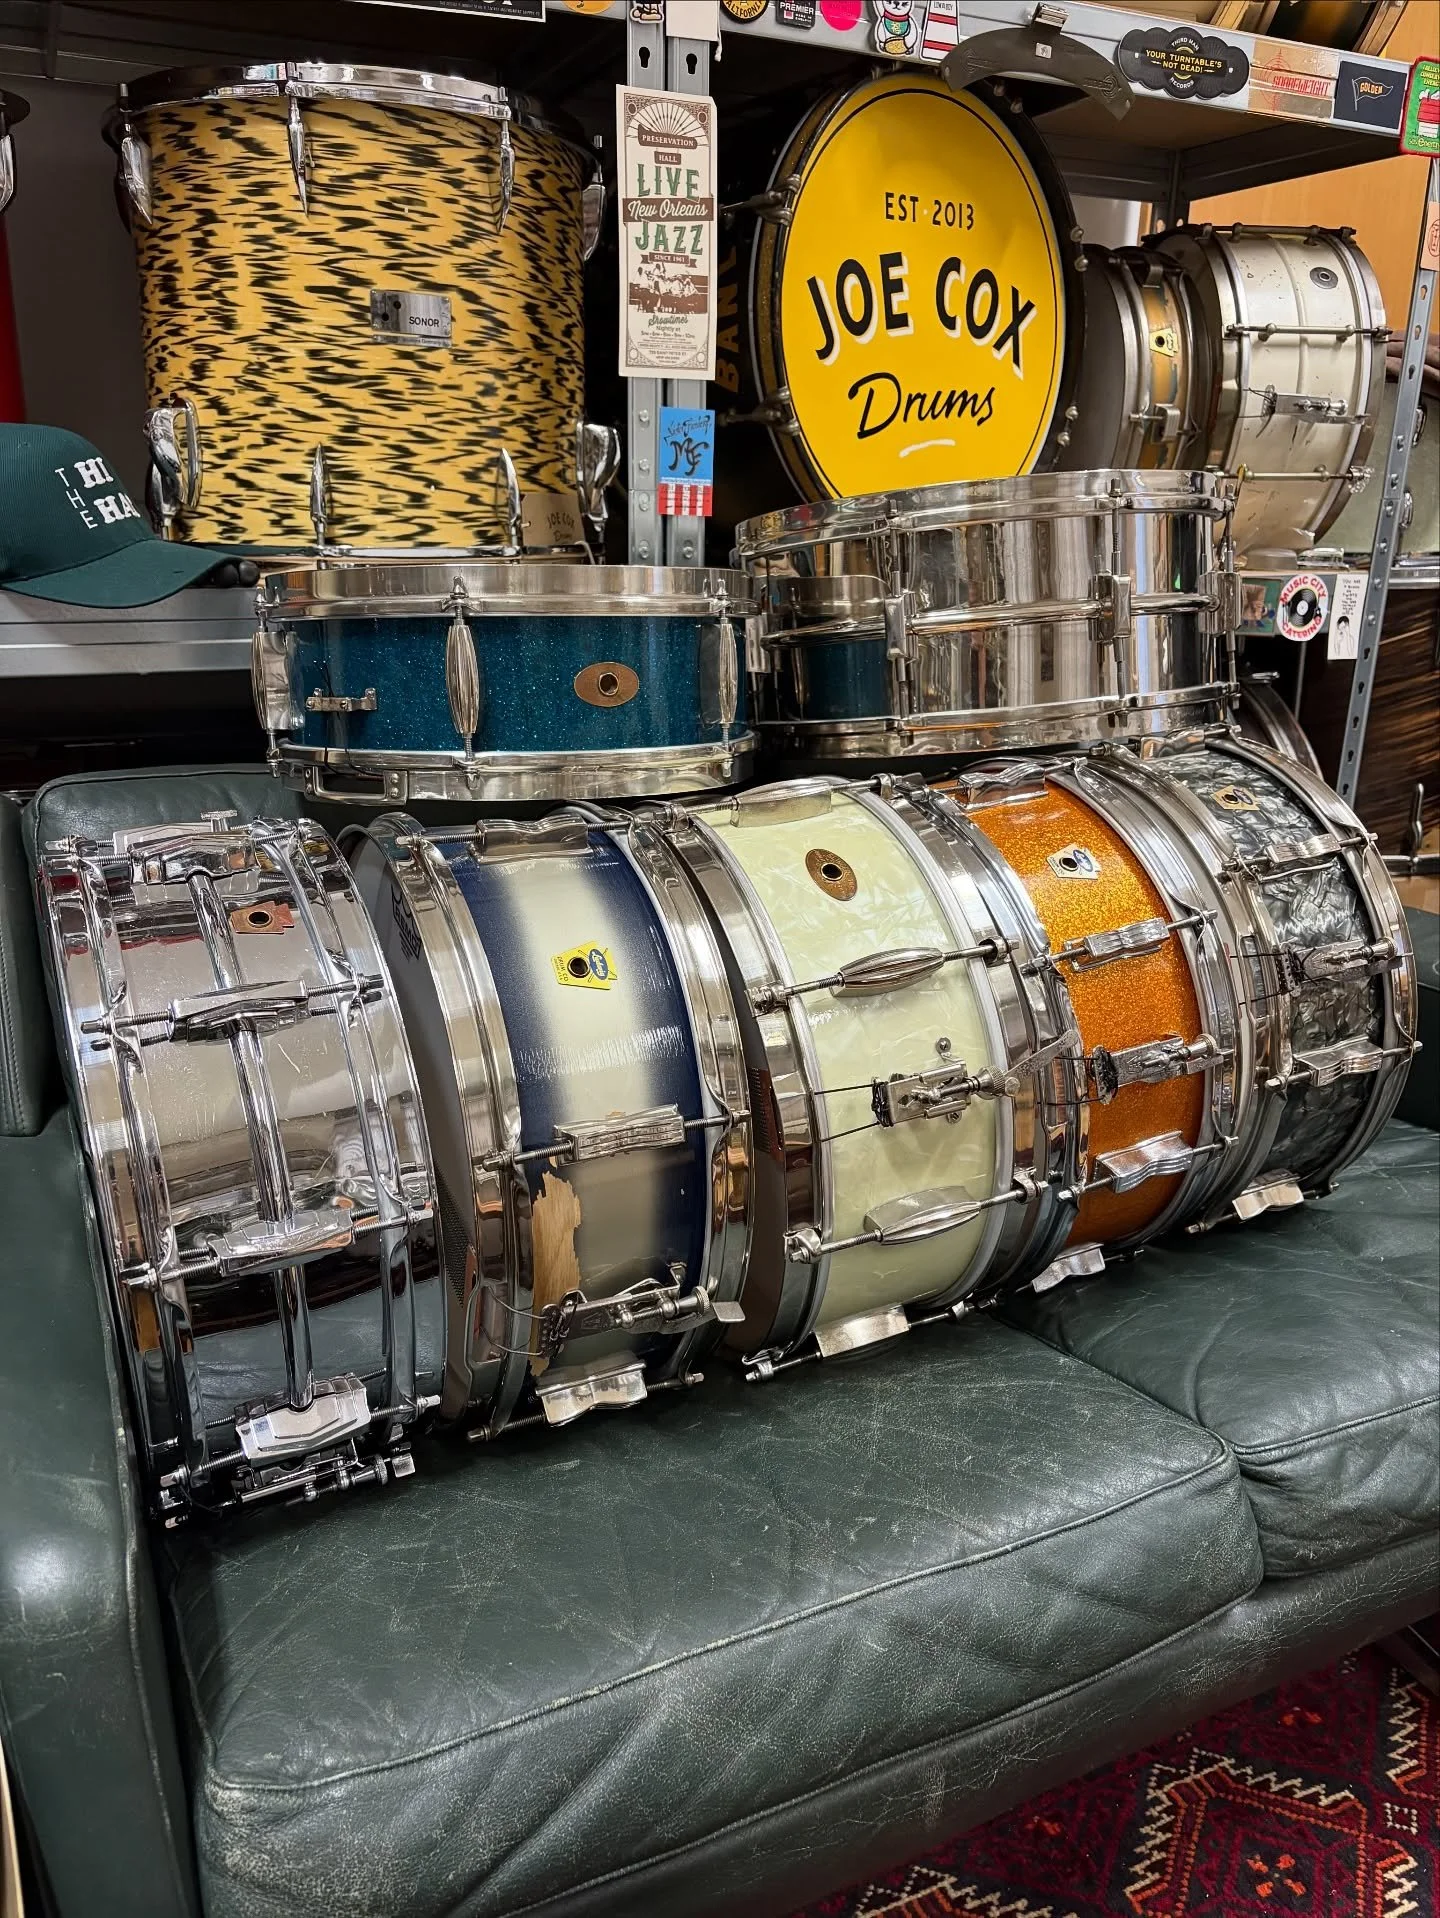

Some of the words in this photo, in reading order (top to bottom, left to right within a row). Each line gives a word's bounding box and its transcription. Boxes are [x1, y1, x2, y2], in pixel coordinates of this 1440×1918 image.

[725, 0, 764, 18] ALIFORNI
[780, 2, 814, 15] PREMIER
[1171, 37, 1188, 47] THIRD
[1188, 38, 1200, 51] MAN
[1145, 49, 1166, 60] YOUR
[1169, 53, 1222, 69] TURNTABLE'S
[1162, 61, 1180, 70] NOT
[1180, 63, 1203, 73] DEAD!
[1169, 76, 1195, 89] RECORDS
[1360, 82, 1384, 95] GOLDEN
[642, 134, 694, 147] PRESERVATION
[659, 154, 678, 163] HALL
[637, 163, 700, 201] LIVE
[628, 200, 658, 220] New
[659, 199, 709, 218] Orleans
[884, 191, 919, 223] EST
[932, 199, 975, 231] 2013
[634, 220, 704, 256] JAZZ
[408, 316, 440, 327] SONOR
[807, 251, 914, 366] JOE
[936, 256, 1037, 381] COX
[847, 371, 996, 440] Drums
[55, 467, 98, 529] THE
[1280, 576, 1309, 606] MUSIC
[1310, 577, 1327, 598] CITY
[1281, 615, 1323, 639] CATERING
